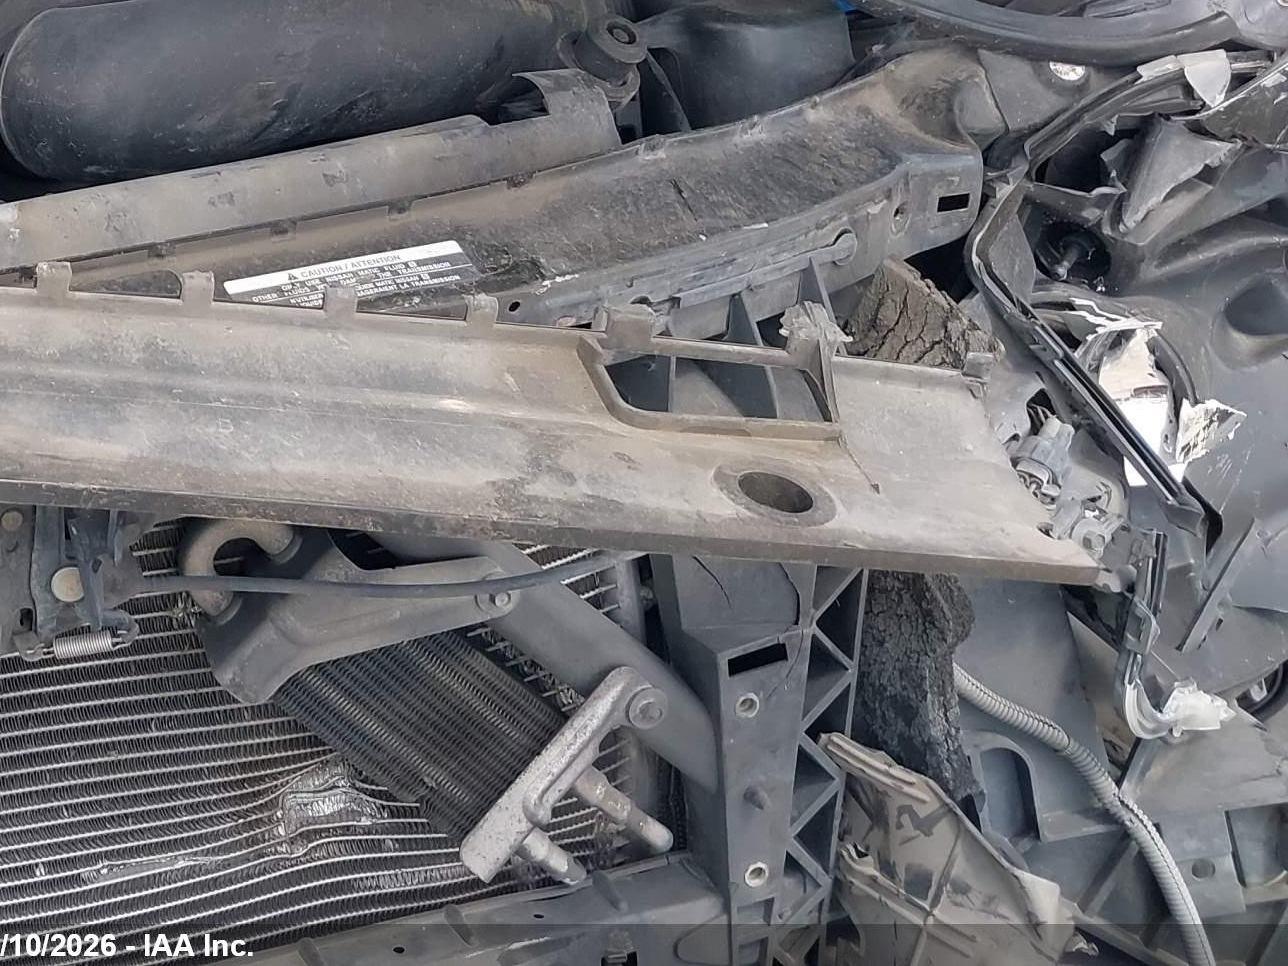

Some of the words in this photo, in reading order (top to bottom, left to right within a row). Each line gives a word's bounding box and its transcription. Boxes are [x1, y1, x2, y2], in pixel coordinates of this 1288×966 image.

[301, 264, 343, 278] CAUTION
[351, 254, 401, 269] ATTENTION
[326, 272, 354, 283] NISSAN
[358, 268, 379, 277] MATIC
[384, 263, 405, 272] FLUID
[252, 293, 278, 303] OTHER
